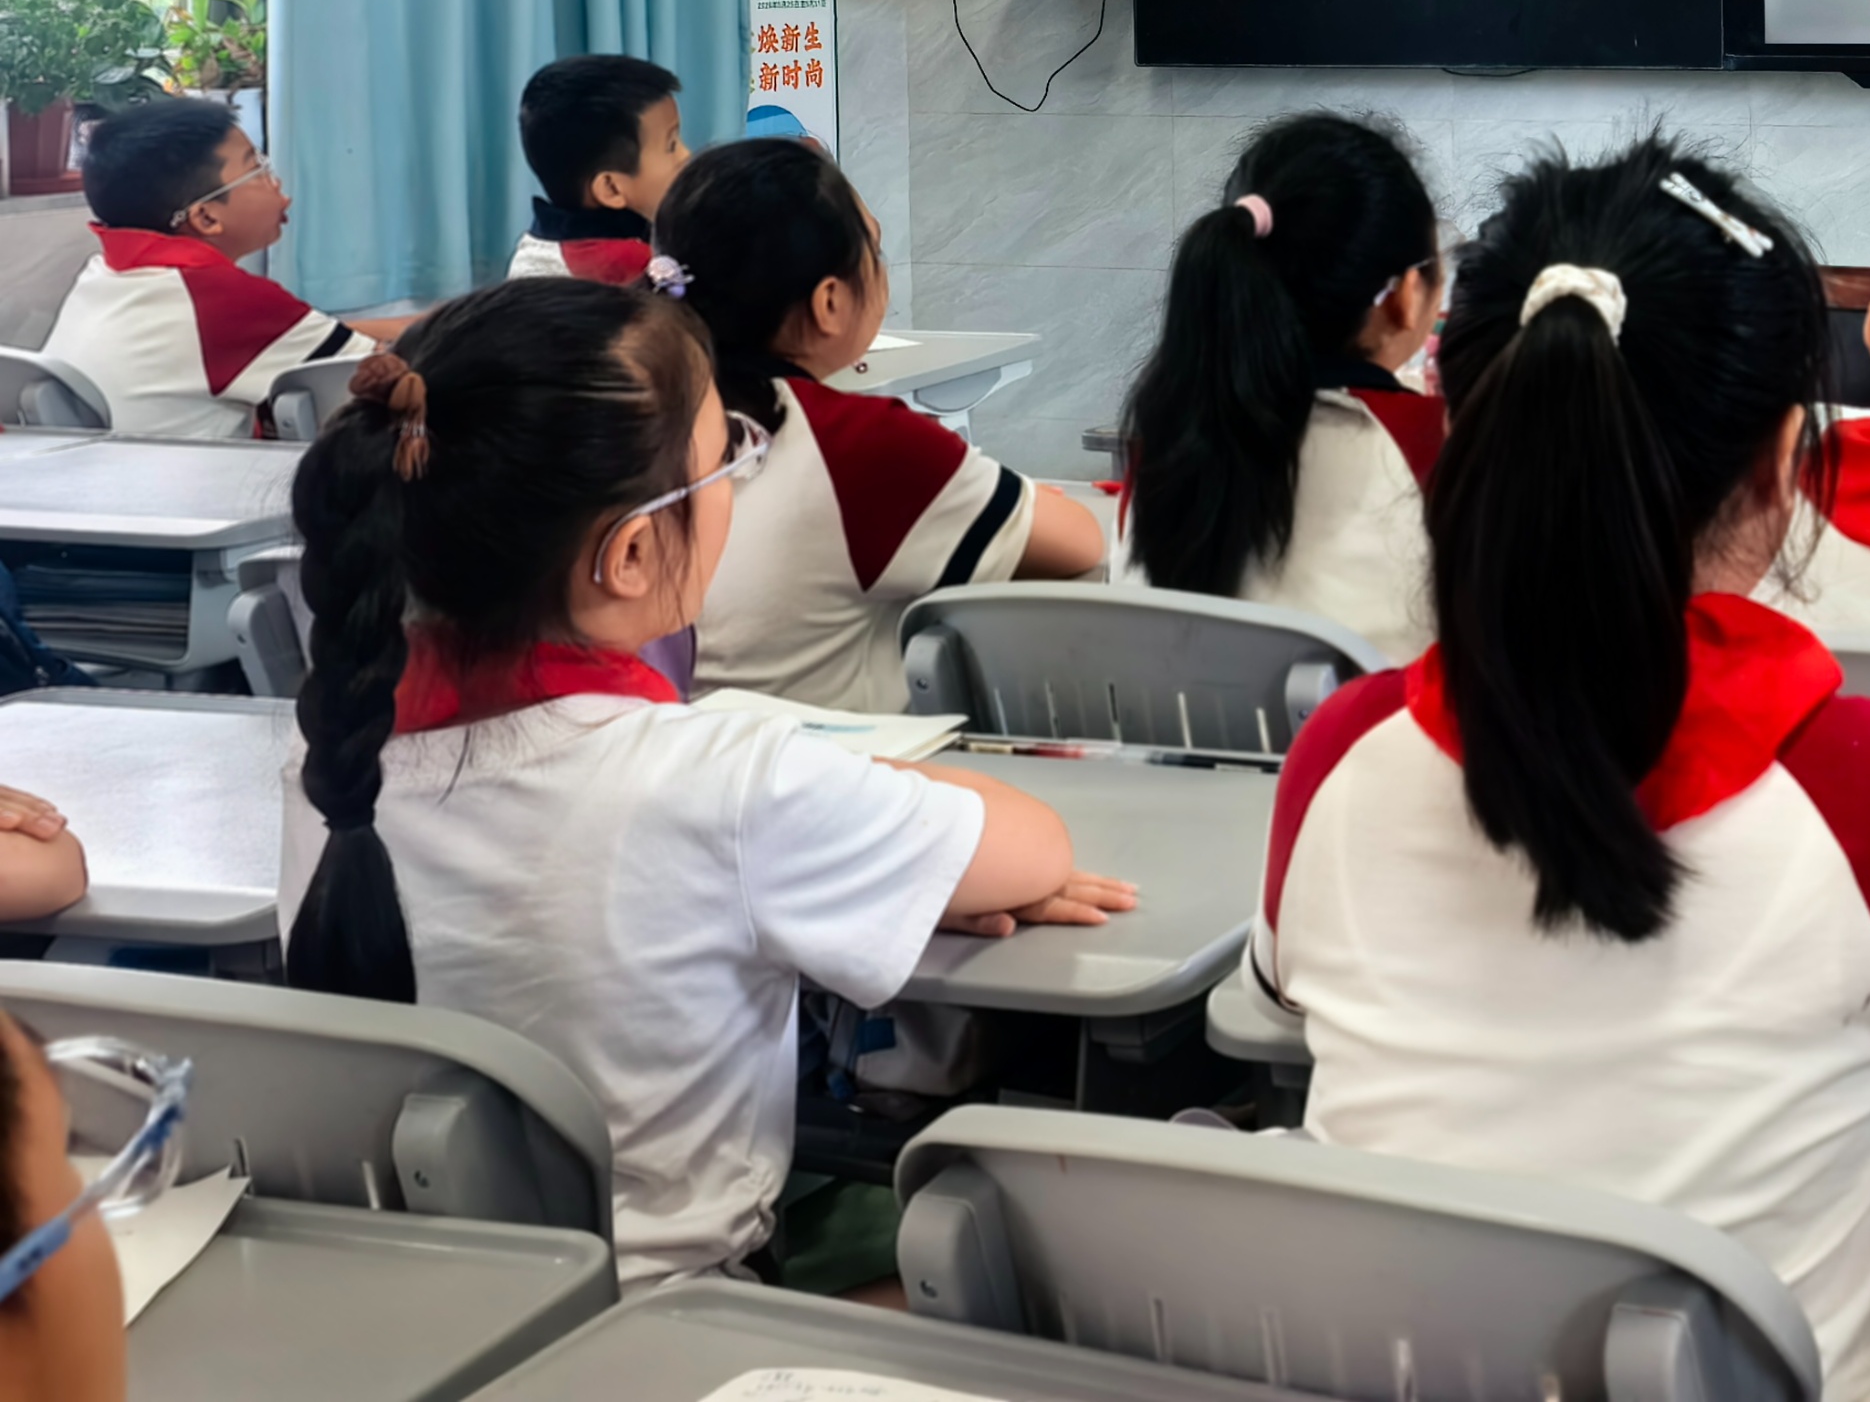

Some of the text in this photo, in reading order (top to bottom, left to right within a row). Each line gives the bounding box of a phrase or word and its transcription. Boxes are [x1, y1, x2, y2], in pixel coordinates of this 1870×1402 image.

[757, 21, 823, 54] 焕新生
[759, 58, 824, 92] 新时尚
